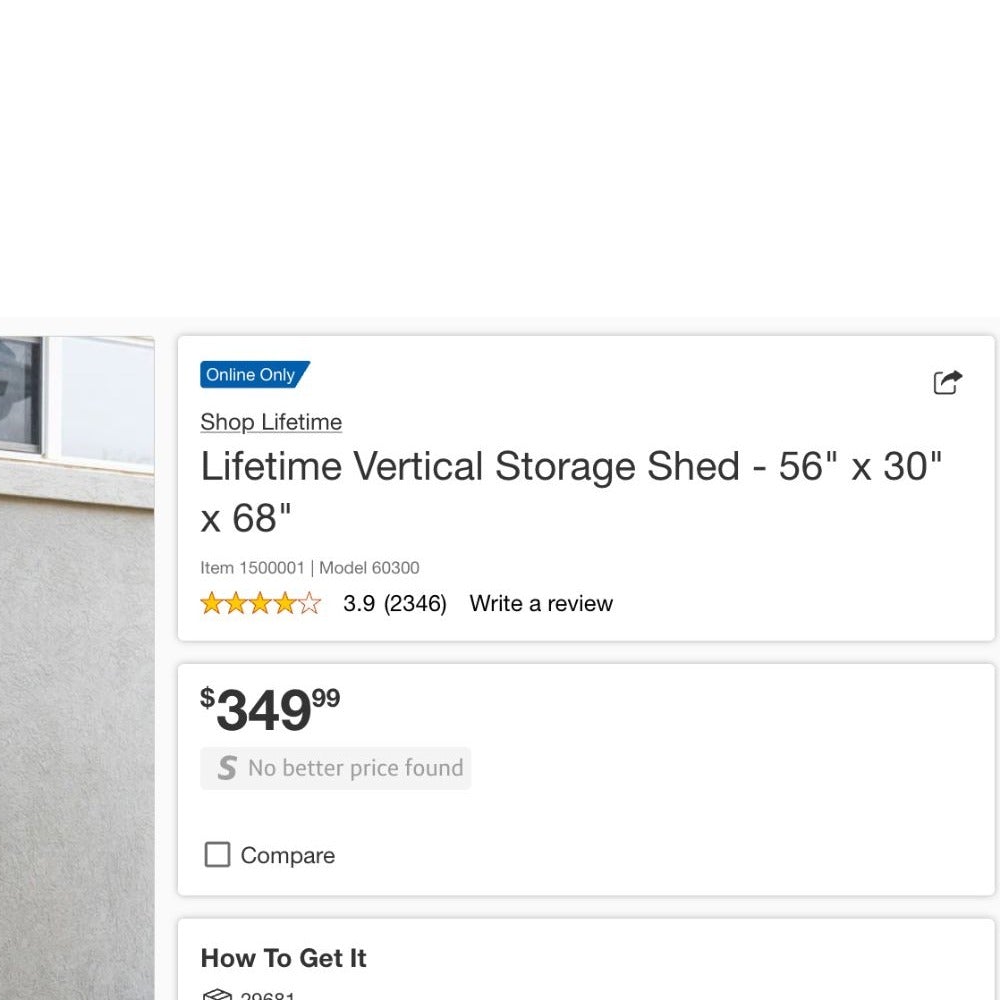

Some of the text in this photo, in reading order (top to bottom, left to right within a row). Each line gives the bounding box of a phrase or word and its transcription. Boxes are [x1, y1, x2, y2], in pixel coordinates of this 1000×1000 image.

[206, 367, 295, 385] Online Only
[200, 412, 343, 433] Shop Lifetime
[202, 450, 342, 481] Lifetime
[352, 450, 482, 481] Vertical
[495, 449, 636, 489] Storage
[647, 449, 739, 482] Shed
[779, 450, 837, 481] 56"
[851, 458, 872, 481] x
[883, 450, 942, 481] 30"
[200, 502, 291, 533] x 68"
[200, 560, 234, 575] Item
[239, 560, 304, 575] 1500001
[319, 560, 367, 575] Model
[371, 560, 420, 575] 60300
[343, 593, 614, 617] 3.9 (2346) Write a review
[249, 758, 277, 777] No
[283, 757, 345, 777] better
[350, 758, 399, 782] price
[404, 757, 464, 777] found
[240, 845, 336, 869] Compare
[201, 947, 367, 968] How To Get It
